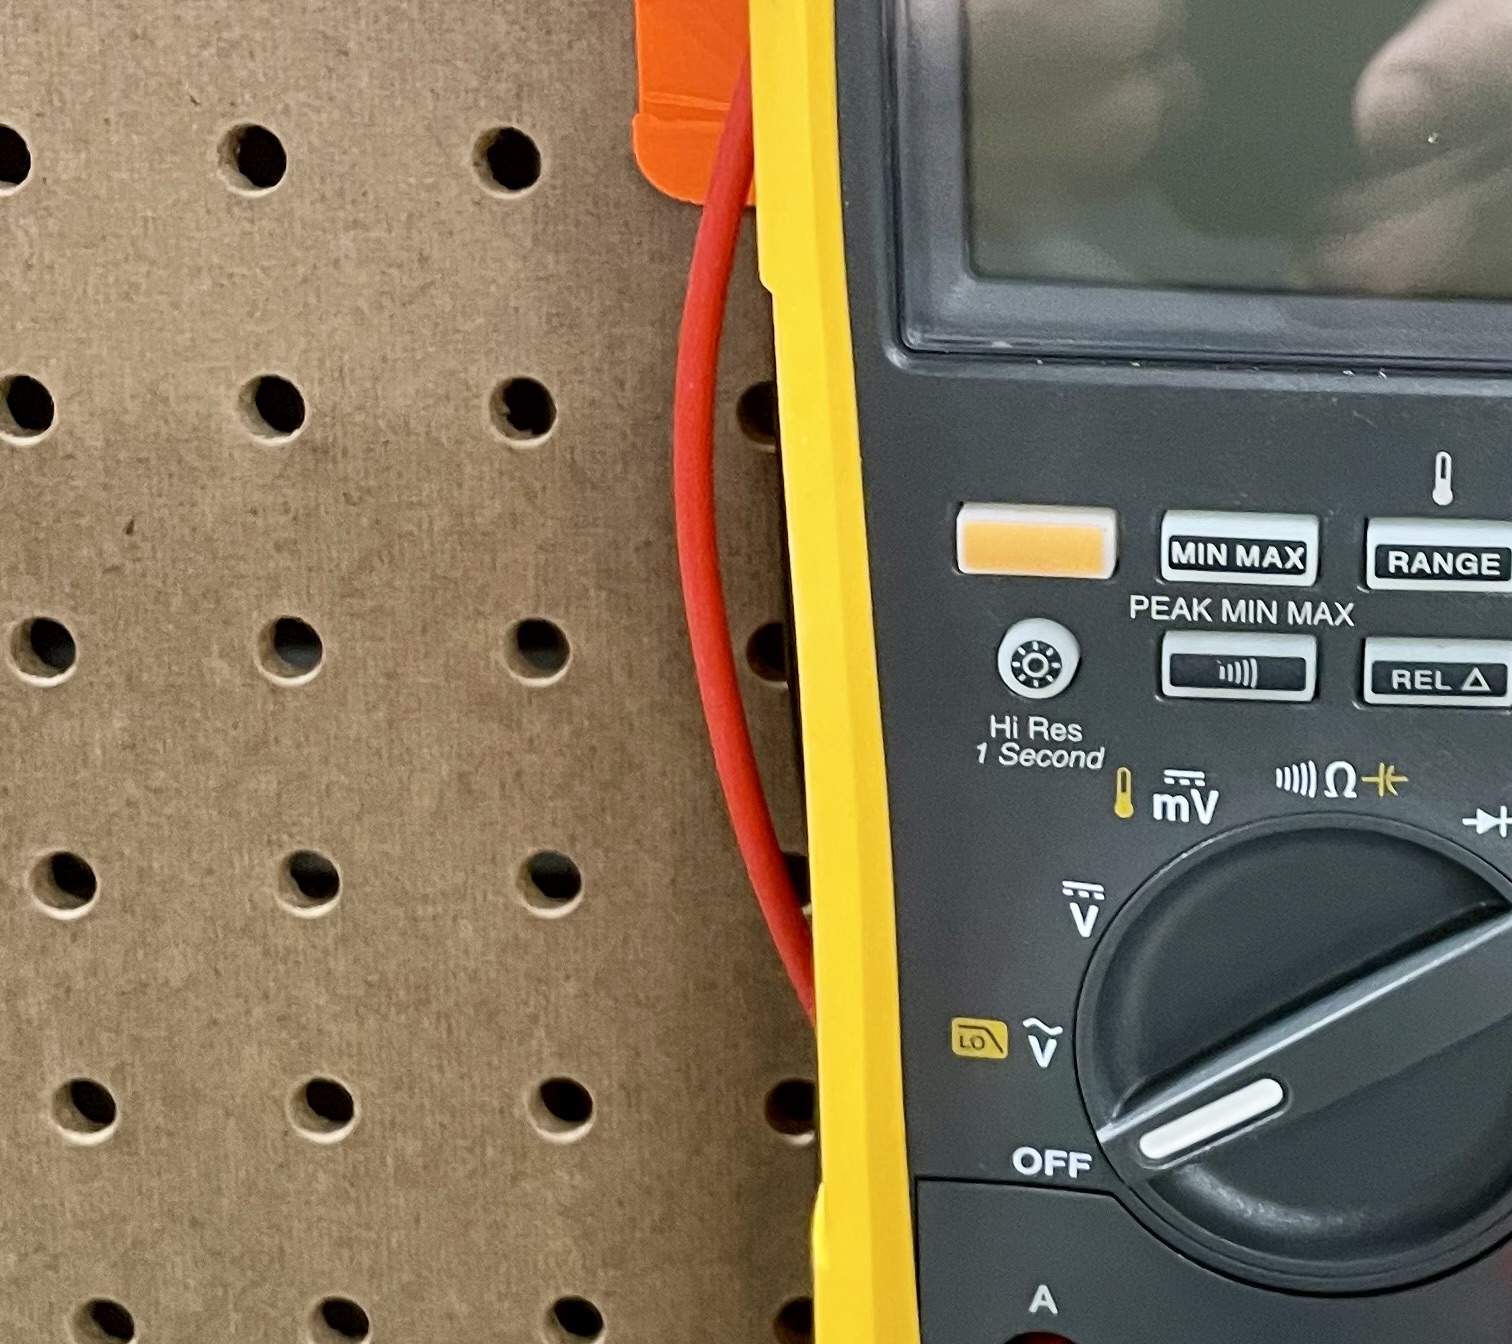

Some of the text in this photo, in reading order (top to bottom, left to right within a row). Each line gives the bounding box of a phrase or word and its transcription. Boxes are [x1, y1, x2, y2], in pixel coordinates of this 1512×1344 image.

[1170, 540, 1305, 570] MIN MAX
[1388, 550, 1501, 576] RANGE
[1130, 594, 1355, 627] PEAK MIN MAX
[1391, 668, 1452, 691] REL
[990, 714, 1083, 743] Hi Res
[976, 741, 1106, 770] 1 Second
[1152, 787, 1220, 825] mV
[1069, 902, 1099, 938] V
[959, 1034, 985, 1051] LO
[1027, 1035, 1058, 1068] V
[1012, 1146, 1093, 1179] OFF
[1028, 1284, 1059, 1315] A
